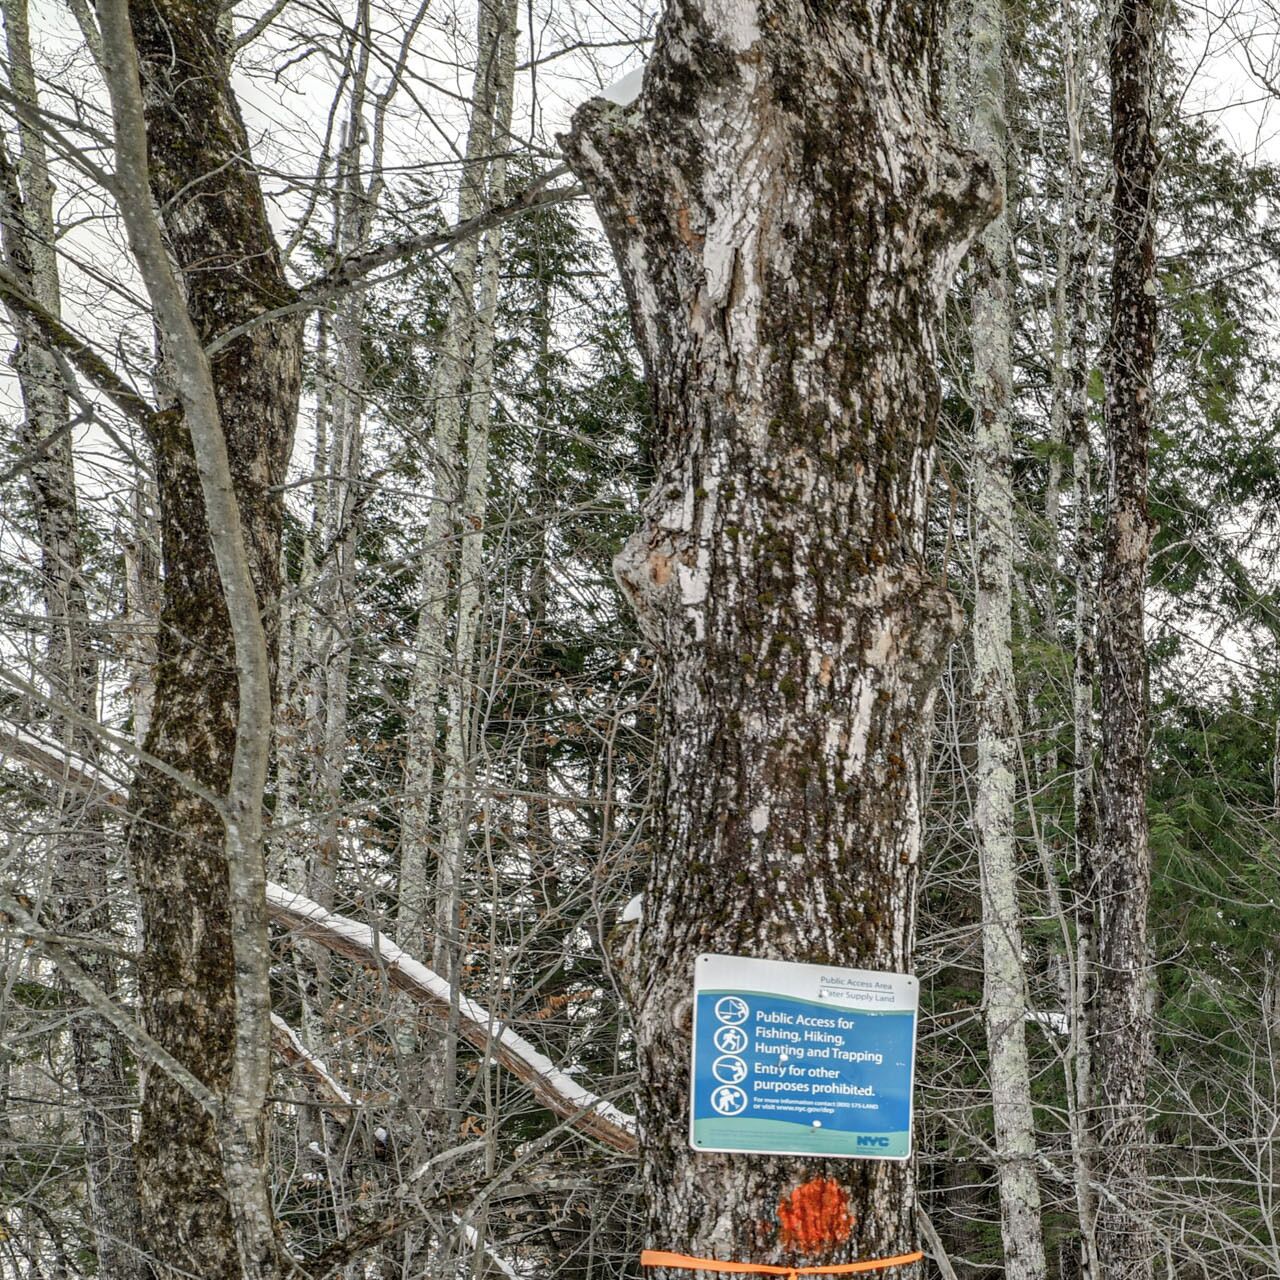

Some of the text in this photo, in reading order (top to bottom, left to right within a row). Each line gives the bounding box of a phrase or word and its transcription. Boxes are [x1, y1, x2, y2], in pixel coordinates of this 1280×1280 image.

[820, 976, 893, 990] Public Access Area
[820, 989, 895, 1003] ater Supply Land
[756, 1010, 854, 1030] Public Access for
[755, 1026, 846, 1047] Fishing, Hiking,
[754, 1042, 883, 1065] Hunting and Trapping
[754, 1062, 841, 1079] Entry for other
[753, 1080, 876, 1097] purposes prohibited.
[761, 1103, 776, 1111] visit
[780, 1098, 814, 1106] information
[814, 1100, 836, 1108] contact
[856, 1135, 890, 1148] NYC
